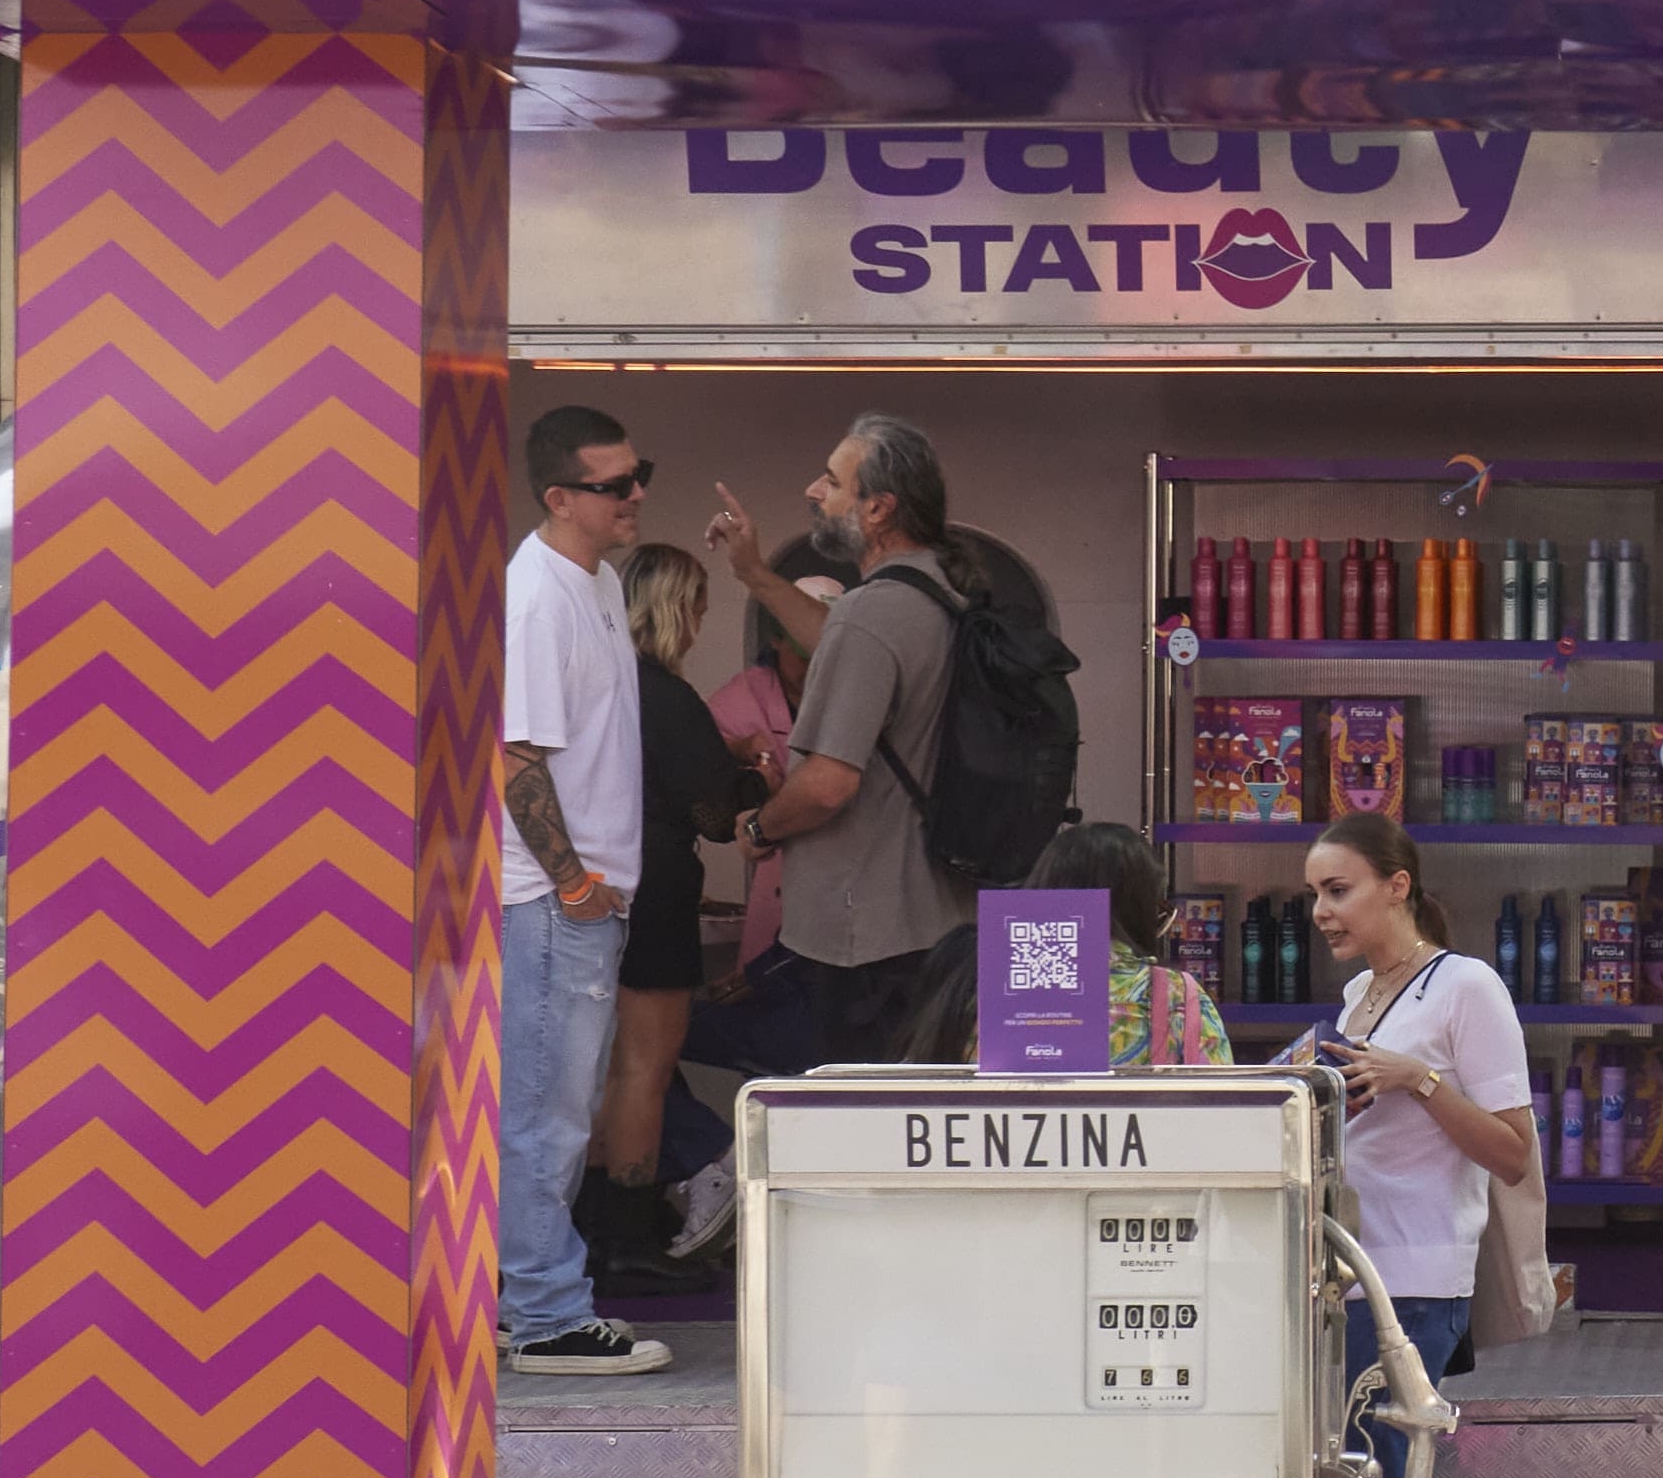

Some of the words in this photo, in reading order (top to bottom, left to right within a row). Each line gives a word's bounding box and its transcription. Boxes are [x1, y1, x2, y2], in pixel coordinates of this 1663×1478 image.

[904, 1112, 1151, 1169] BENZINA
[1122, 1243, 1175, 1254] LIRE
[1118, 1330, 1178, 1340] LITRI
